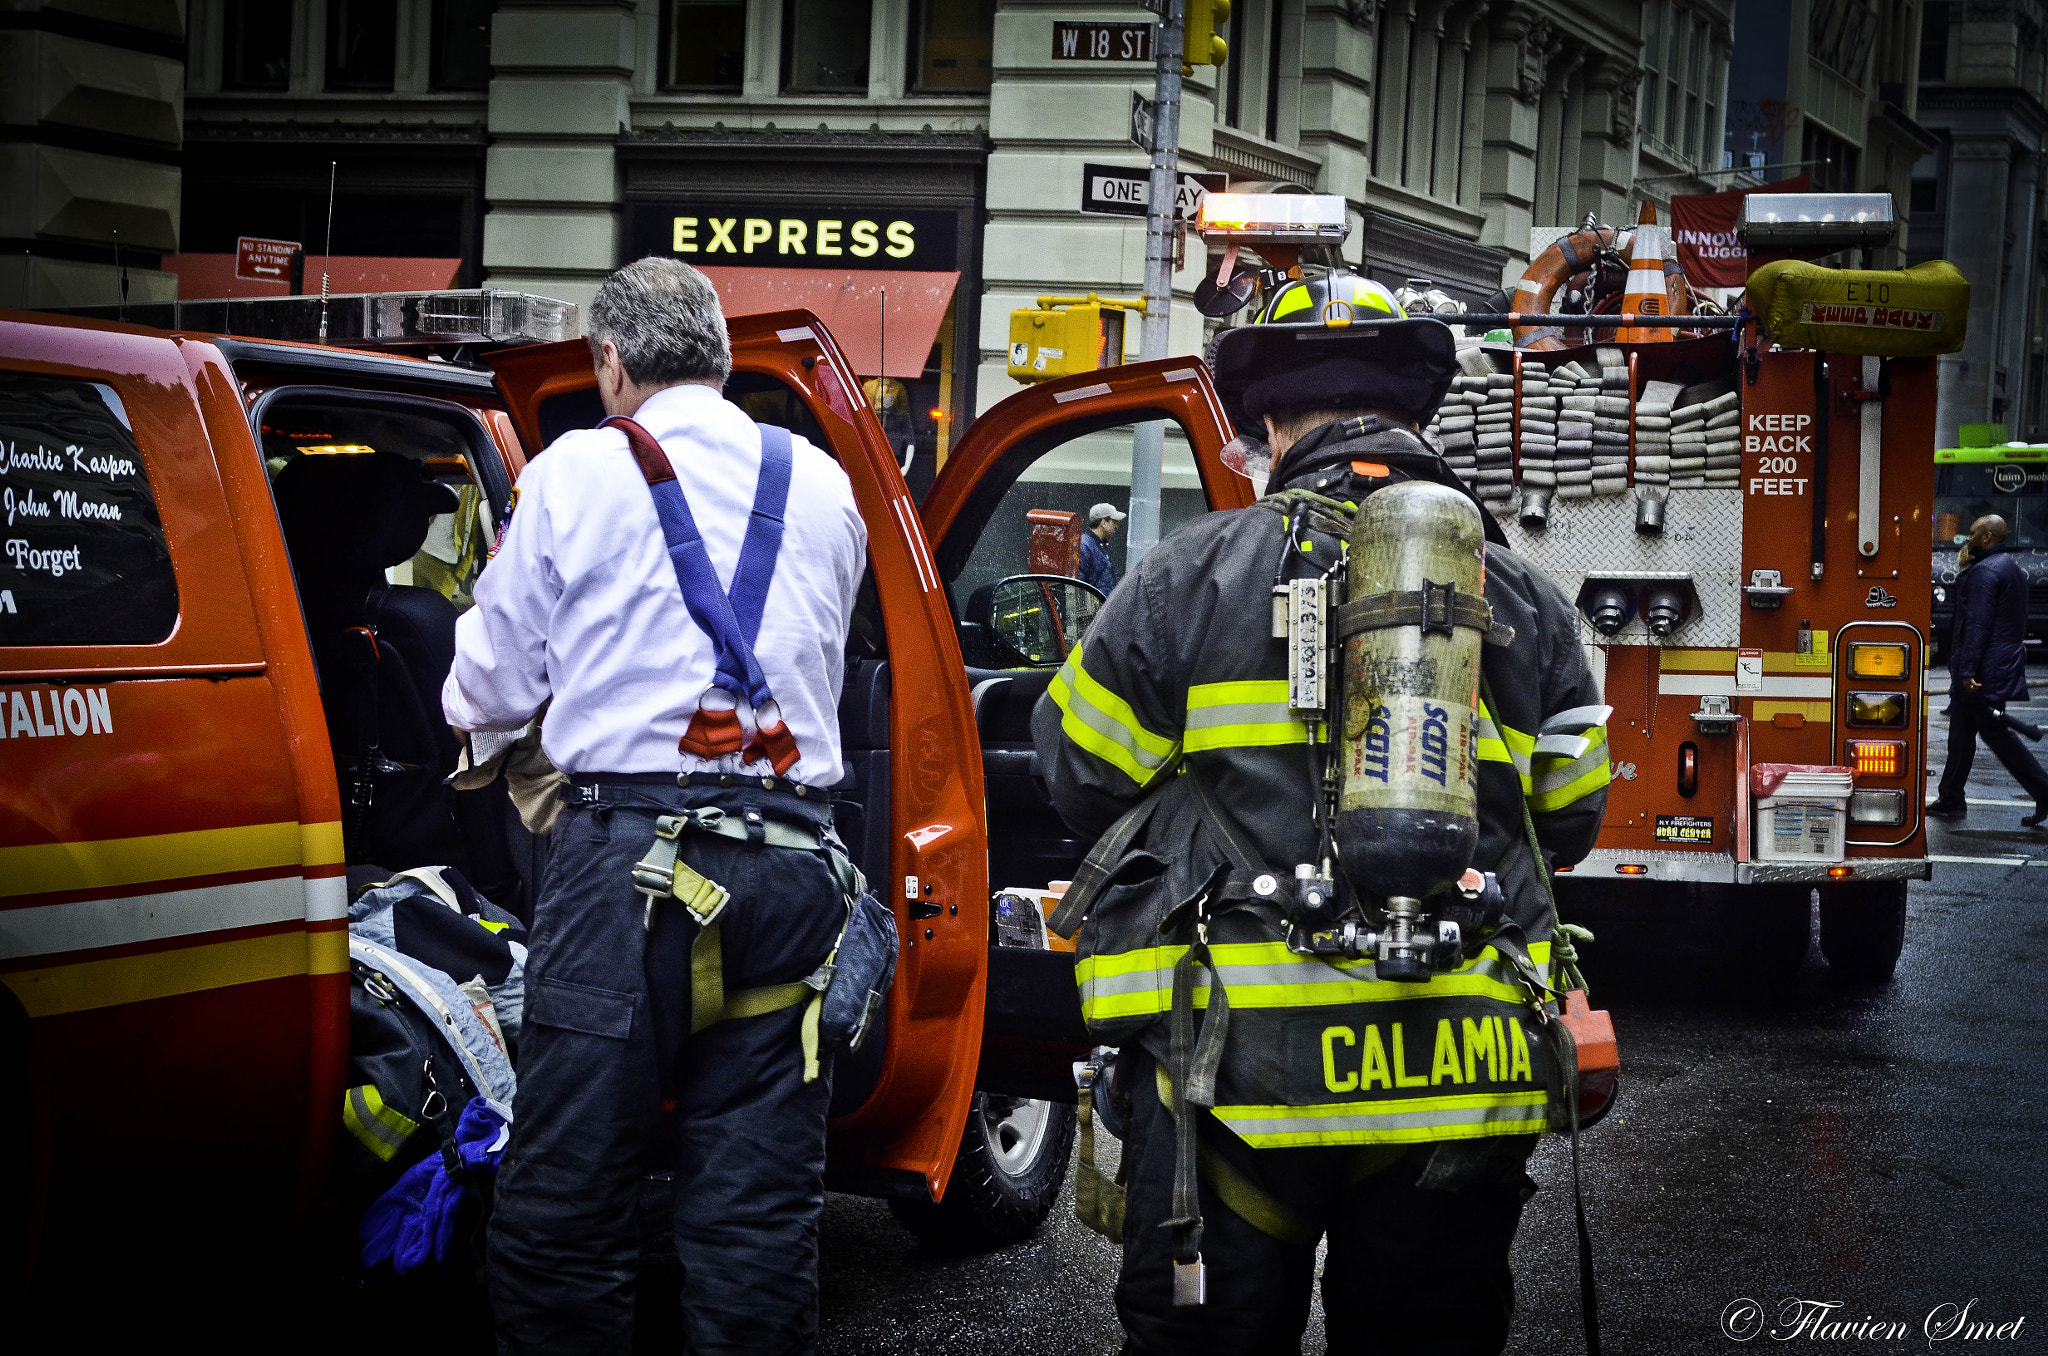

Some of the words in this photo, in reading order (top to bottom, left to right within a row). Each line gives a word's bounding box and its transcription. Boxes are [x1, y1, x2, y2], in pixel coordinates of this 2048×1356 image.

[1062, 29, 1079, 57] W
[1090, 29, 1110, 58] 18
[1121, 30, 1145, 59] ST
[1103, 180, 1142, 201] ONE
[1175, 188, 1203, 206] AY
[242, 242, 254, 251] NO
[673, 217, 915, 258] EXPRESS
[1677, 229, 1741, 246] INNOV
[248, 254, 288, 266] ANYTIME
[1811, 303, 1868, 325] KEEP
[1873, 307, 1933, 330] BACK
[1749, 414, 1811, 432] KEEP
[1745, 435, 1812, 453] BACK
[65, 444, 136, 481] Kasper
[1758, 456, 1797, 474] 200
[1749, 478, 1809, 496] FEET
[3, 486, 51, 527] John
[53, 489, 122, 521] Moran
[5, 539, 83, 577] Forget
[1421, 702, 1449, 787] SCOTT
[1656, 826, 1678, 837] BURN
[1680, 827, 1712, 839] CENTER
[1321, 1015, 1532, 1093] CALAMIA
